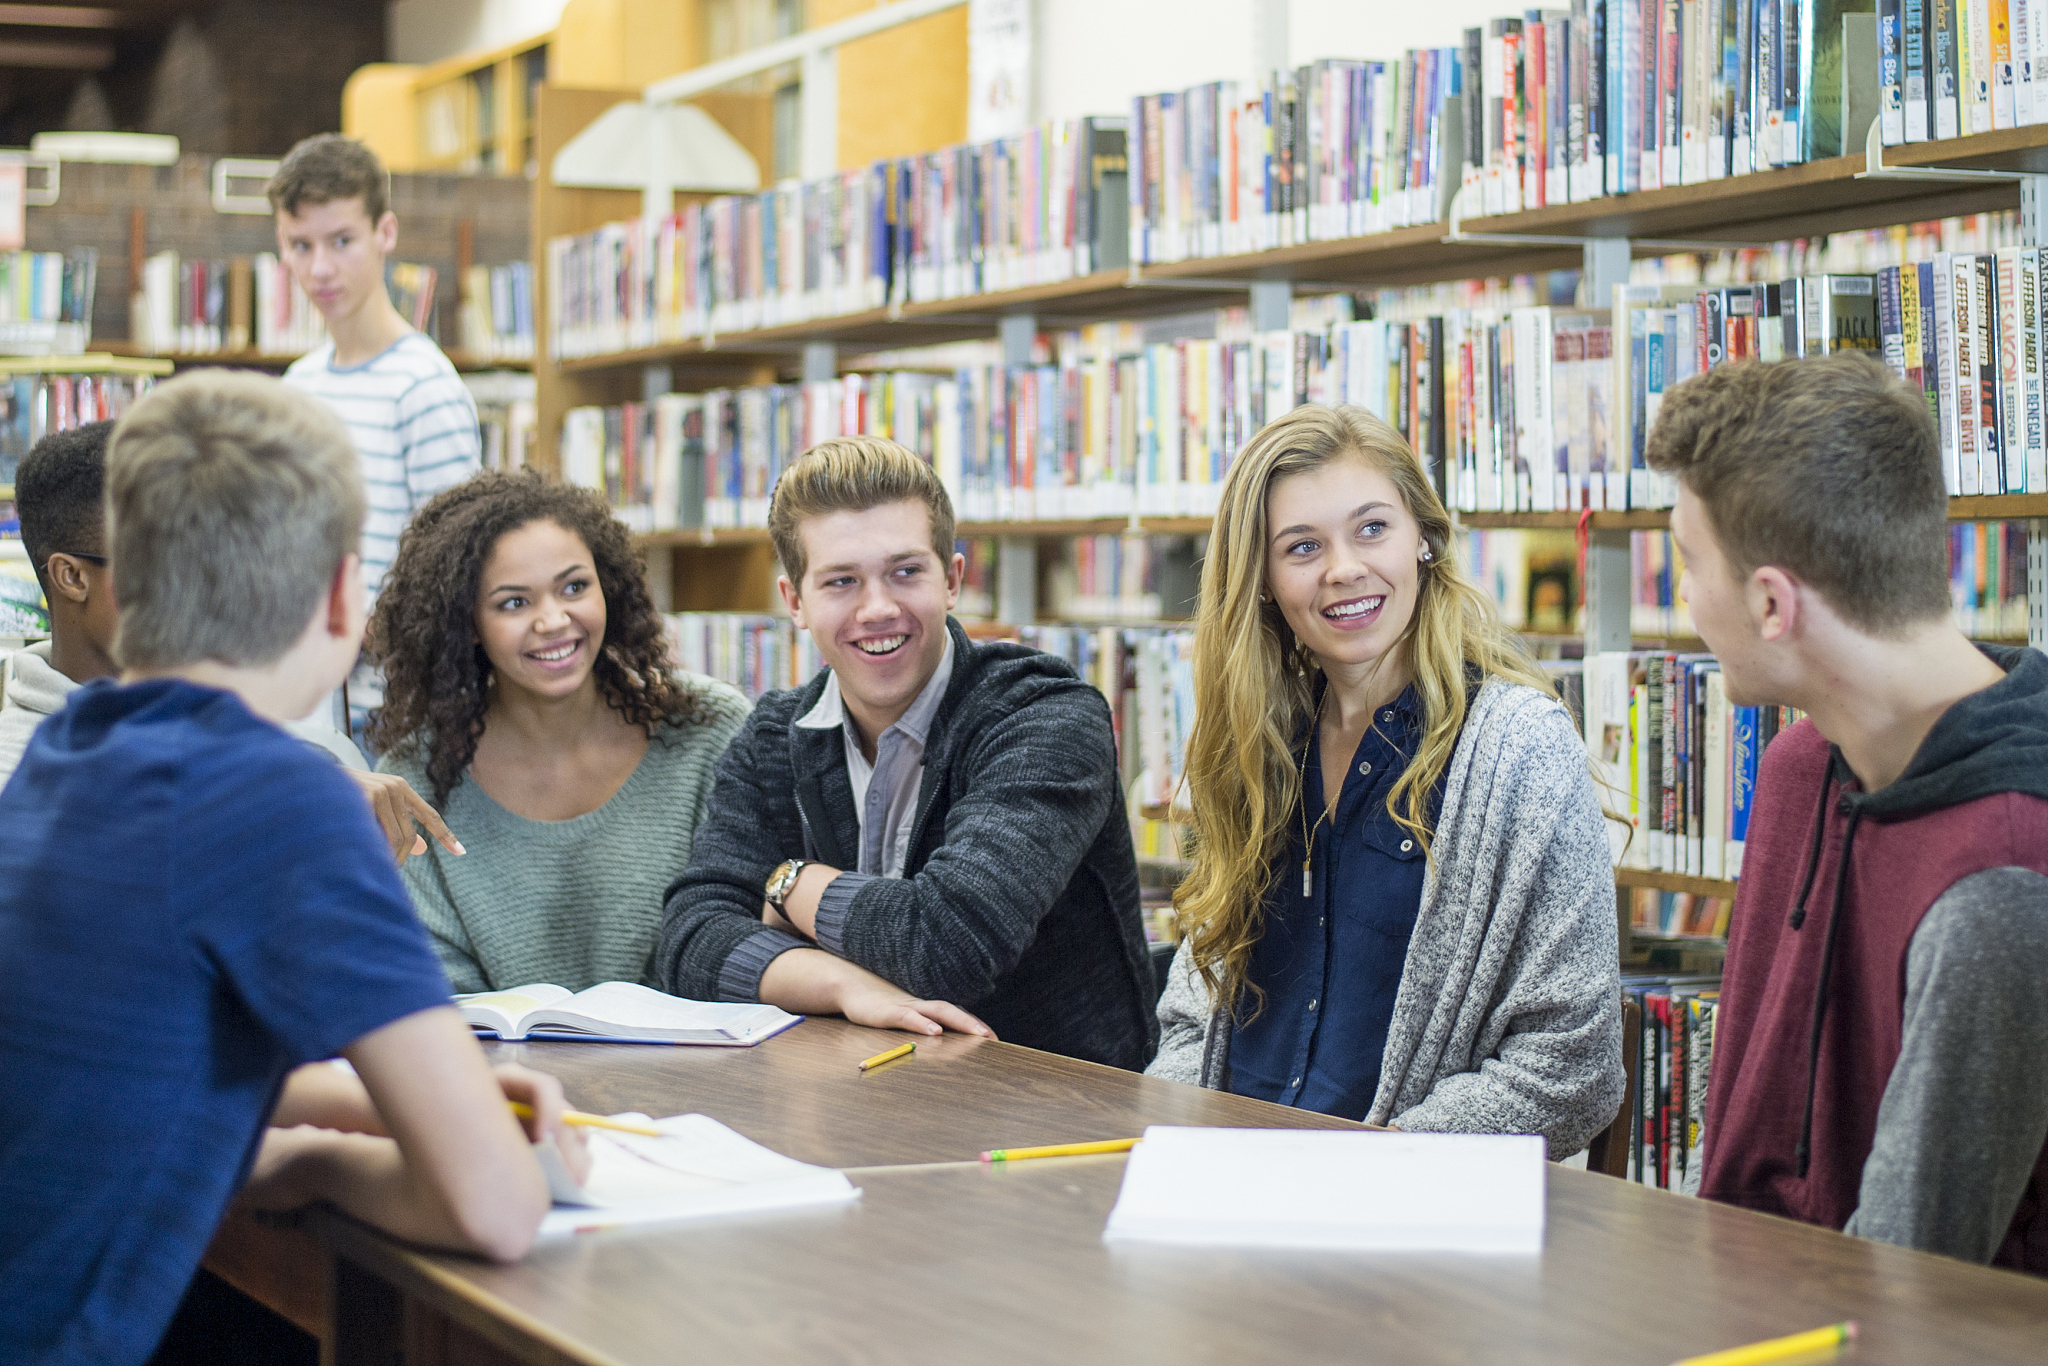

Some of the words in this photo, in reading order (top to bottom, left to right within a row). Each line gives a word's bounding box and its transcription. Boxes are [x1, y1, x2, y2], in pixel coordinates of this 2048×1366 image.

[1882, 15, 1896, 55] back
[1936, 0, 1950, 30] rker
[2016, 0, 2028, 45] PAINTED
[1936, 31, 1950, 64] Blue
[1996, 43, 2008, 62] SPL
[1883, 58, 1897, 87] Sto
[1955, 274, 1968, 333] JEFFERSON
[1976, 271, 1987, 327] JEFFERSON
[1998, 258, 2014, 309] LITTLE
[2023, 267, 2036, 329] JEFFERSON
[1902, 273, 1912, 345] PARKER
[1884, 333, 1905, 373] ROB
[1935, 319, 1951, 402] MEASURE
[1958, 336, 1971, 377] PARKER
[1978, 328, 1989, 366] PARKER
[2000, 313, 2017, 383] SAIGON
[2024, 331, 2037, 374] PARKER
[1960, 384, 1973, 415] IRON
[2026, 379, 2039, 392] THE
[1982, 405, 1994, 428] OUT
[2026, 393, 2041, 450] RENEGADE
